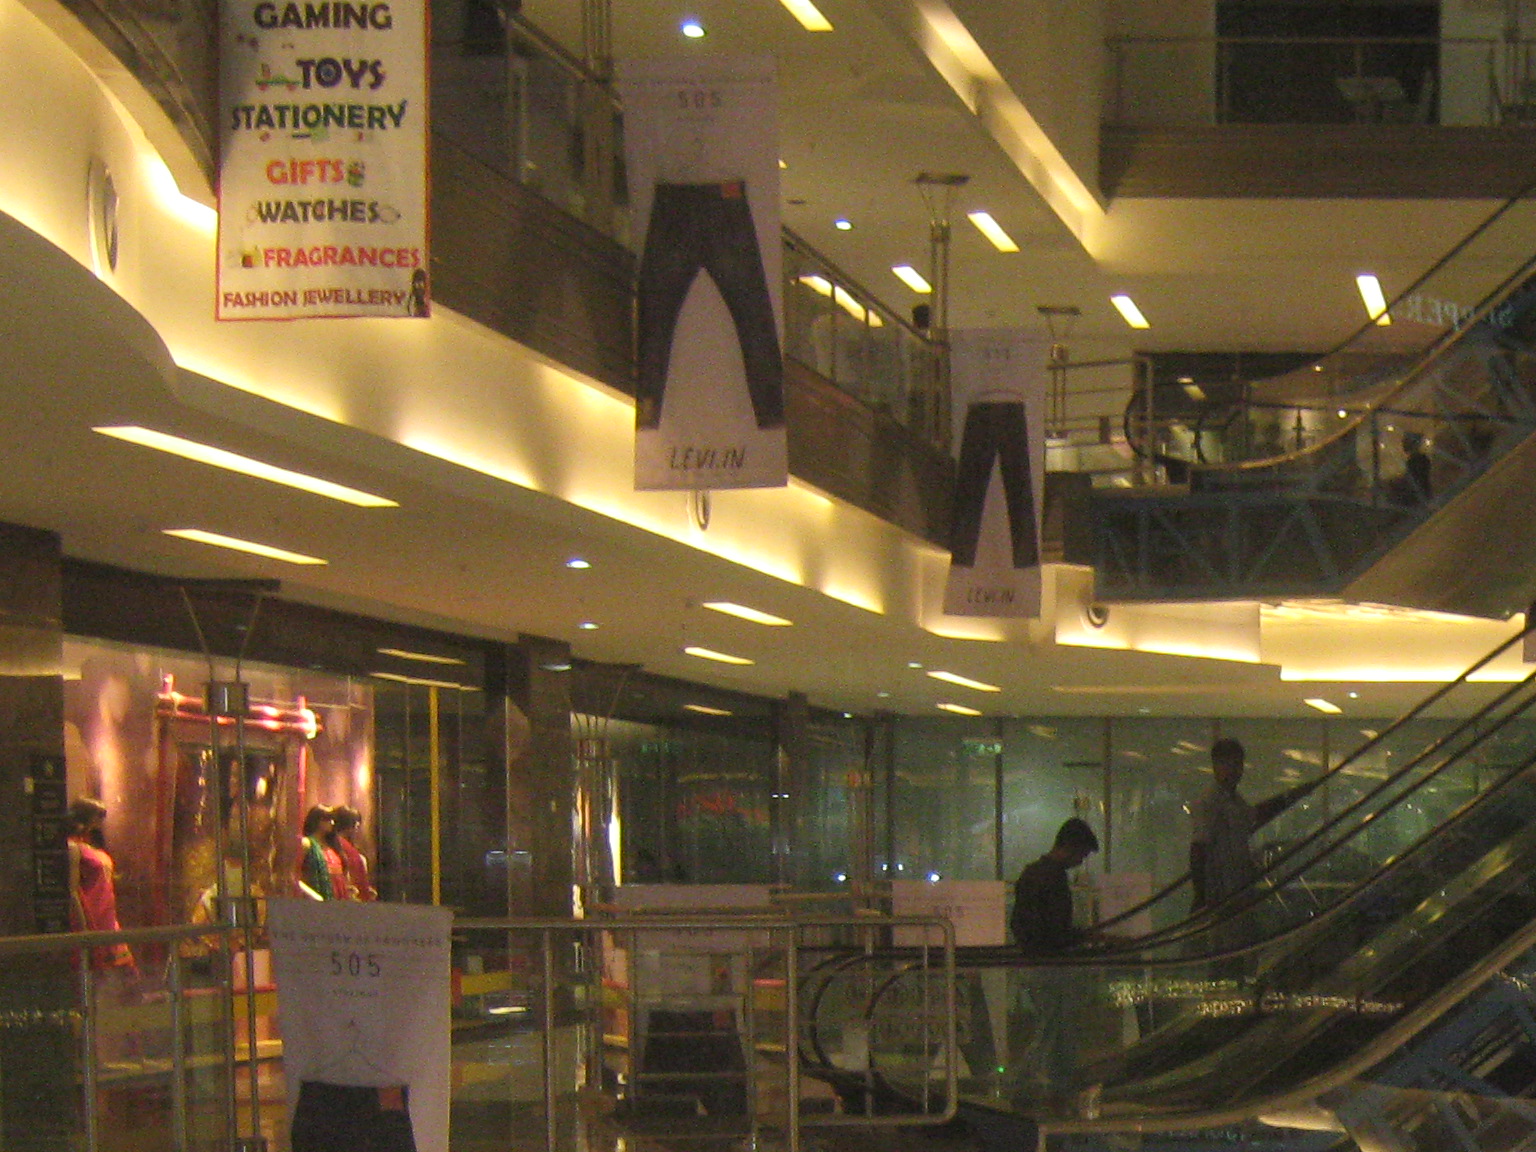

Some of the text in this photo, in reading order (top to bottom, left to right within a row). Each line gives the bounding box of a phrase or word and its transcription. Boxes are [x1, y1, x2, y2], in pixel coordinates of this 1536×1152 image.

[253, 3, 393, 30] GAMING
[296, 57, 386, 90] TOYS
[231, 99, 408, 131] STATIONERY
[265, 159, 345, 185] GIFTS
[257, 200, 379, 224] WATCHES
[263, 247, 422, 269] FRAGRANCES
[223, 287, 406, 308] FASHION JEWELLERY
[330, 950, 383, 978] 505
